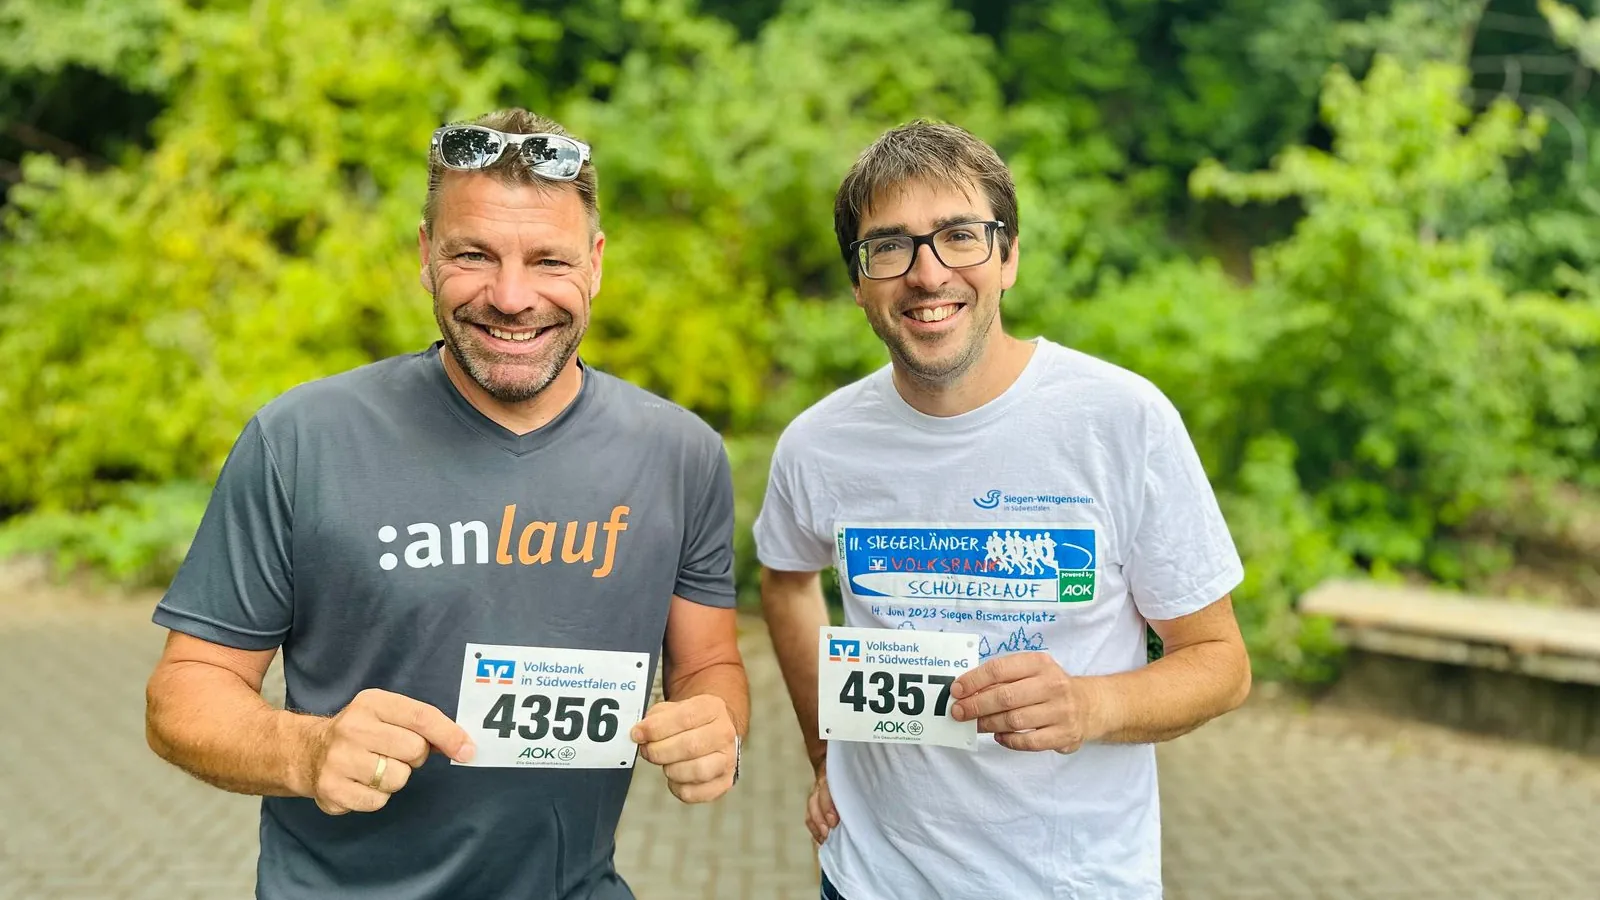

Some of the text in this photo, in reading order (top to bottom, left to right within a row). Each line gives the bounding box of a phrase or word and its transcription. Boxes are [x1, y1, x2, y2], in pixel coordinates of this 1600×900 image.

[1003, 495, 1094, 505] Siegen-Wittgenstein
[867, 532, 979, 552] SIEGERLÄNDER
[891, 556, 1002, 574] VOLKSBANK
[1085, 571, 1094, 579] by
[908, 576, 1042, 599] SCHÜLERLAUF
[1061, 584, 1093, 597] AOK
[871, 605, 1057, 624] 14. Juni 2023 Siegen Bismarckplatz
[866, 641, 919, 653] Volksbank
[523, 661, 585, 675] Volksbank
[865, 653, 969, 668] in Südwestfalen eG
[521, 674, 637, 691] in Südwestfalen eG
[839, 670, 956, 717] 4357
[482, 693, 620, 743] 4356
[873, 720, 906, 733] AOK
[518, 747, 556, 759] AOK
